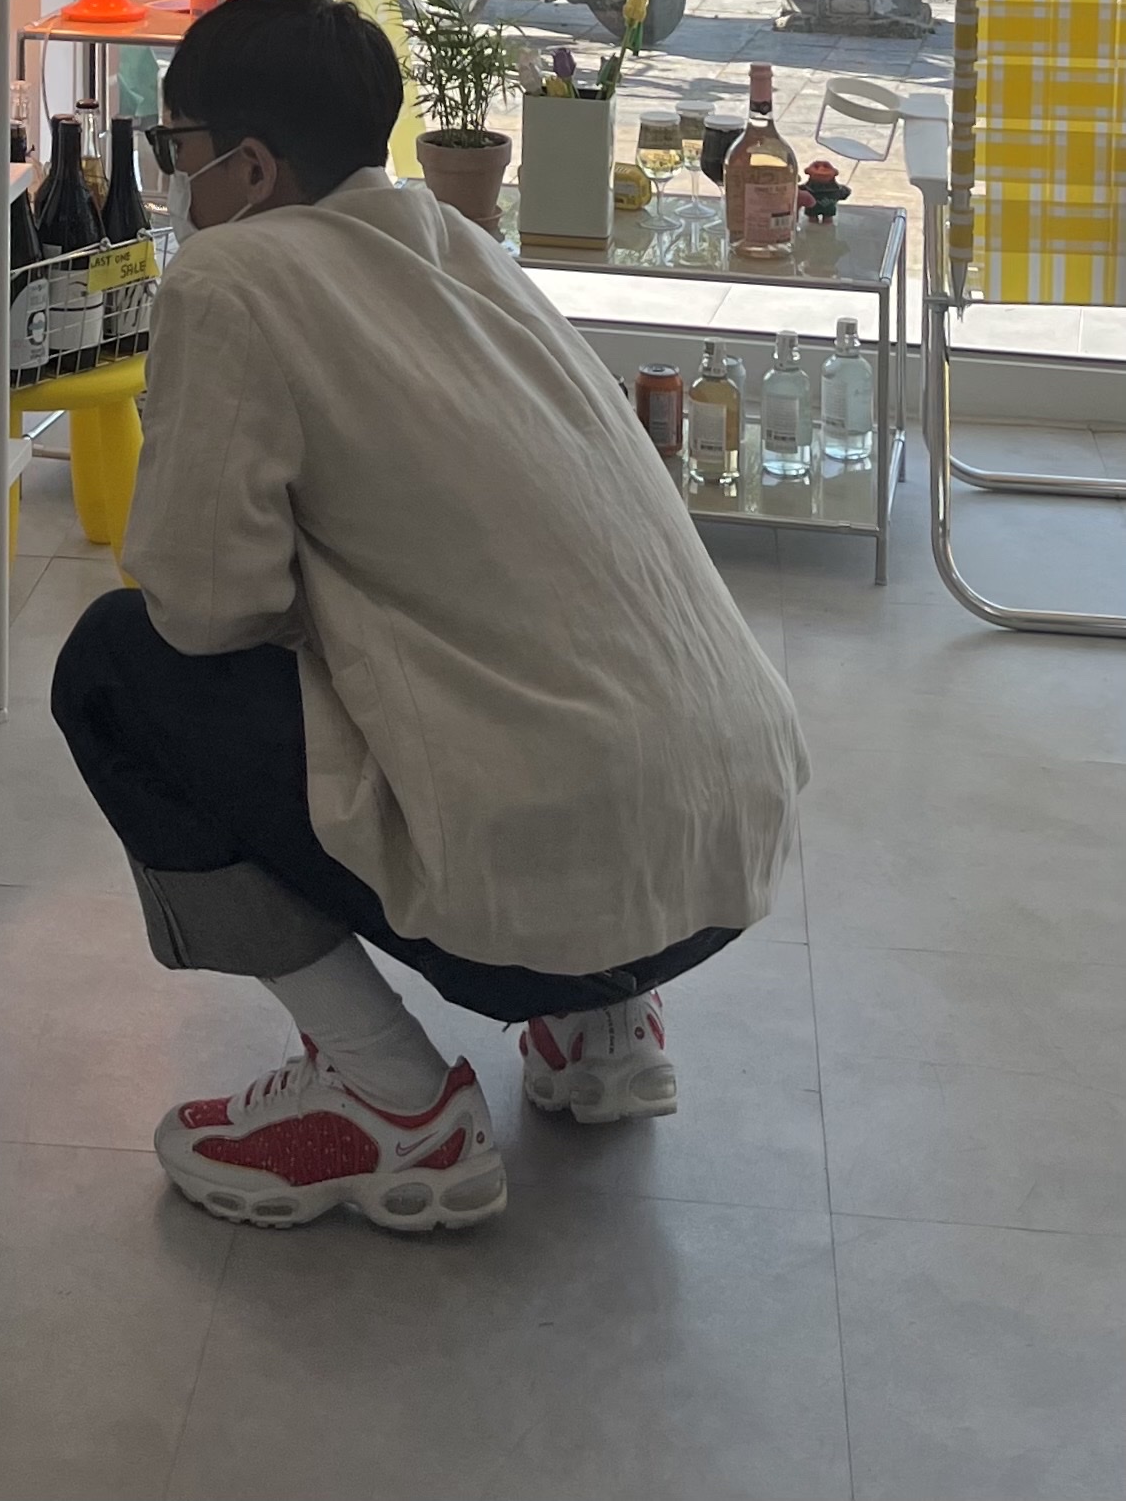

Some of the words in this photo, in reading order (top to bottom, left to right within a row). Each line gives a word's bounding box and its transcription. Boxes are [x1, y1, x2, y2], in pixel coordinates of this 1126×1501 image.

[91, 255, 111, 268] LAST
[115, 251, 130, 264] ONE
[120, 260, 146, 279] SALE
